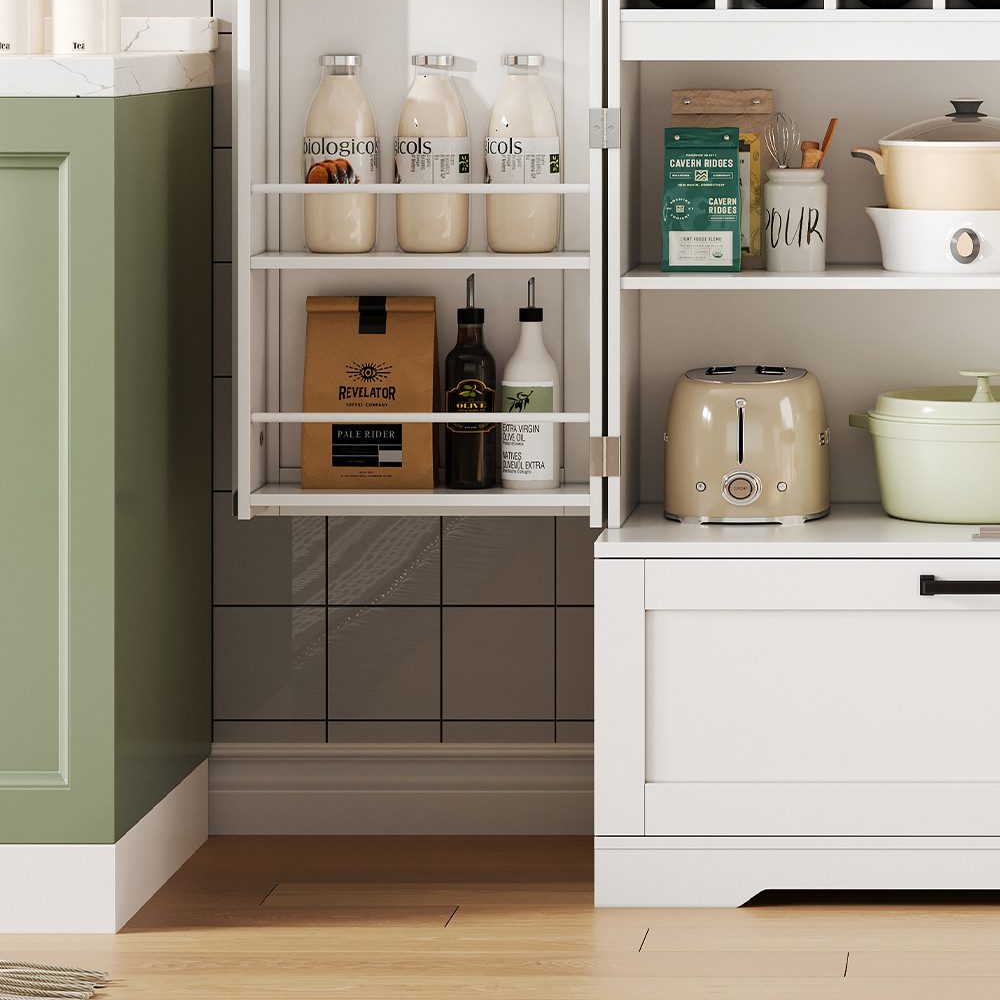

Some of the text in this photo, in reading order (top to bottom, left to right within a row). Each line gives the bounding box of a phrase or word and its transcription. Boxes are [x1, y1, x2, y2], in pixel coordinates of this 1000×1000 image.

[72, 42, 86, 50] Tea
[669, 159, 733, 168] CAVERN RIDGES
[708, 198, 737, 206] CAVERN
[708, 206, 737, 214] RIDGES
[338, 385, 396, 401] REVELATOR
[518, 424, 540, 433] VIRGIN
[337, 430, 395, 438] PALE RIDER
[525, 461, 545, 469] EXTRA
